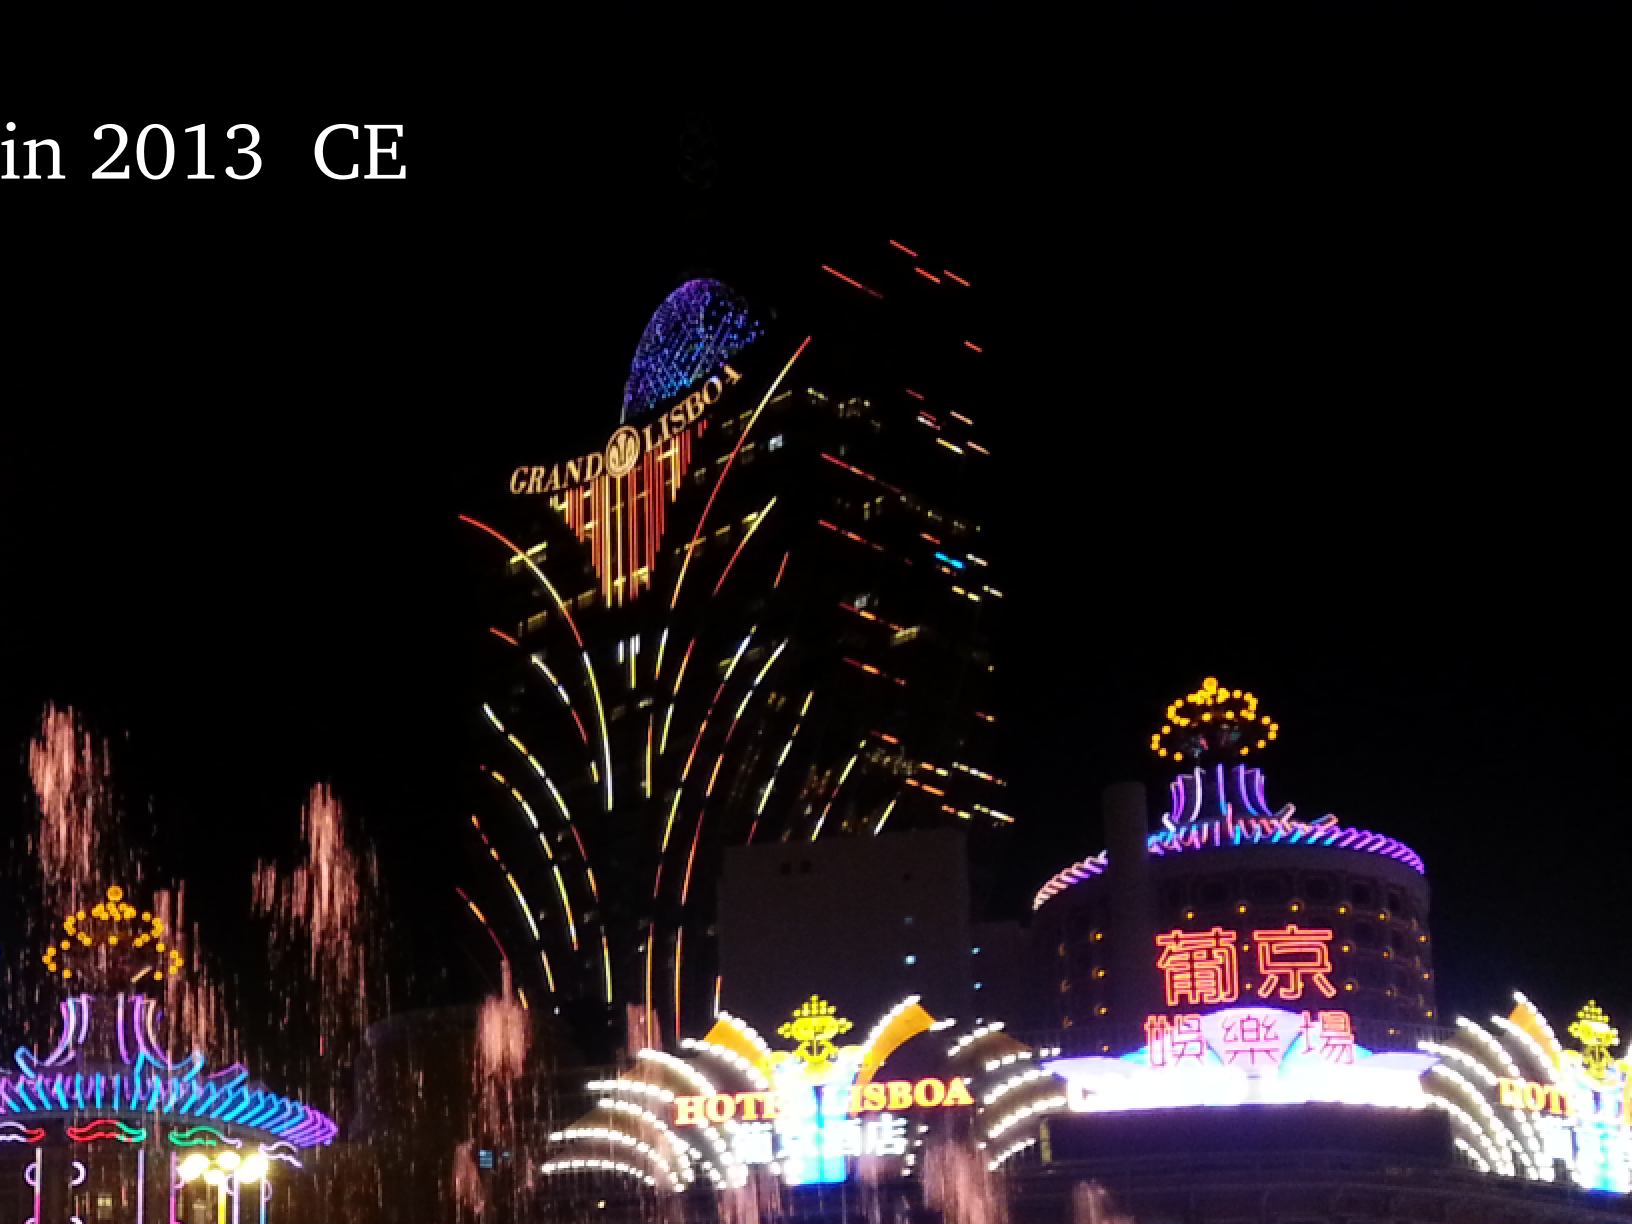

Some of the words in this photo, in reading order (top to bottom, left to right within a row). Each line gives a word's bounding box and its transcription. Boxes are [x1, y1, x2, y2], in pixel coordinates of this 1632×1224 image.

[509, 451, 604, 495] GRAND
[641, 363, 744, 453] LISBOA
[1155, 924, 1338, 1006] 葡京
[674, 1090, 804, 1126] HOTE
